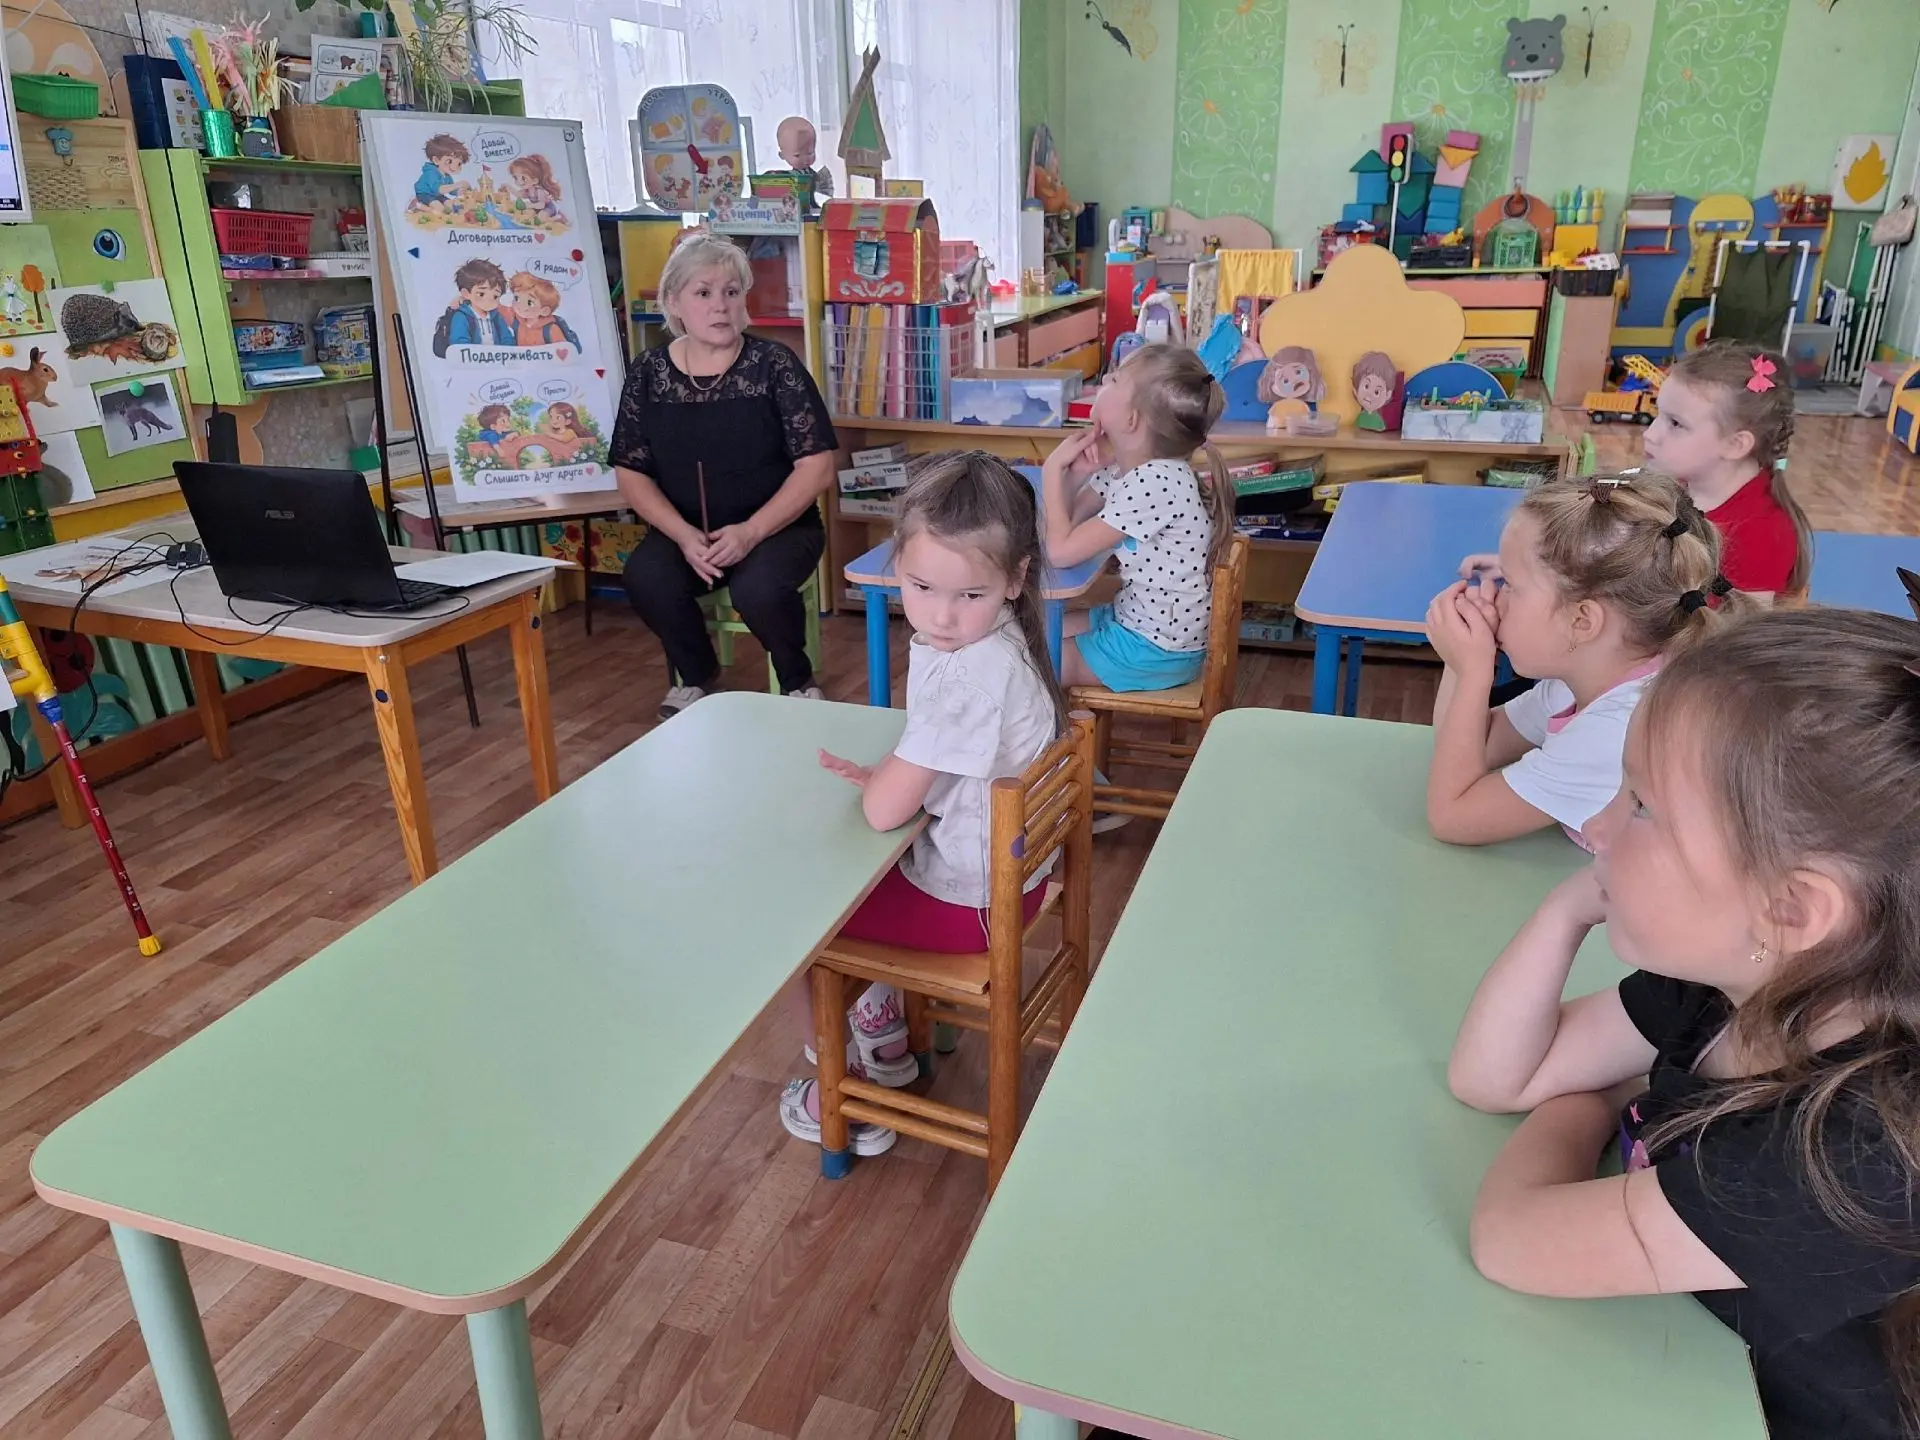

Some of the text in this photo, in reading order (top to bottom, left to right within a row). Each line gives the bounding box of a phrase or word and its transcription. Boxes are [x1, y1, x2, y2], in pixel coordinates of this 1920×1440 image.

[707, 88, 731, 105] УТРО
[481, 136, 506, 150] Давай
[484, 145, 514, 158] вместе!
[447, 230, 533, 246] Договариваться
[534, 260, 569, 275] Я рядом
[460, 348, 553, 365] Поддерживать
[484, 473, 530, 485] Слышать
[558, 468, 584, 480] друга
[265, 509, 295, 519] ASUS
